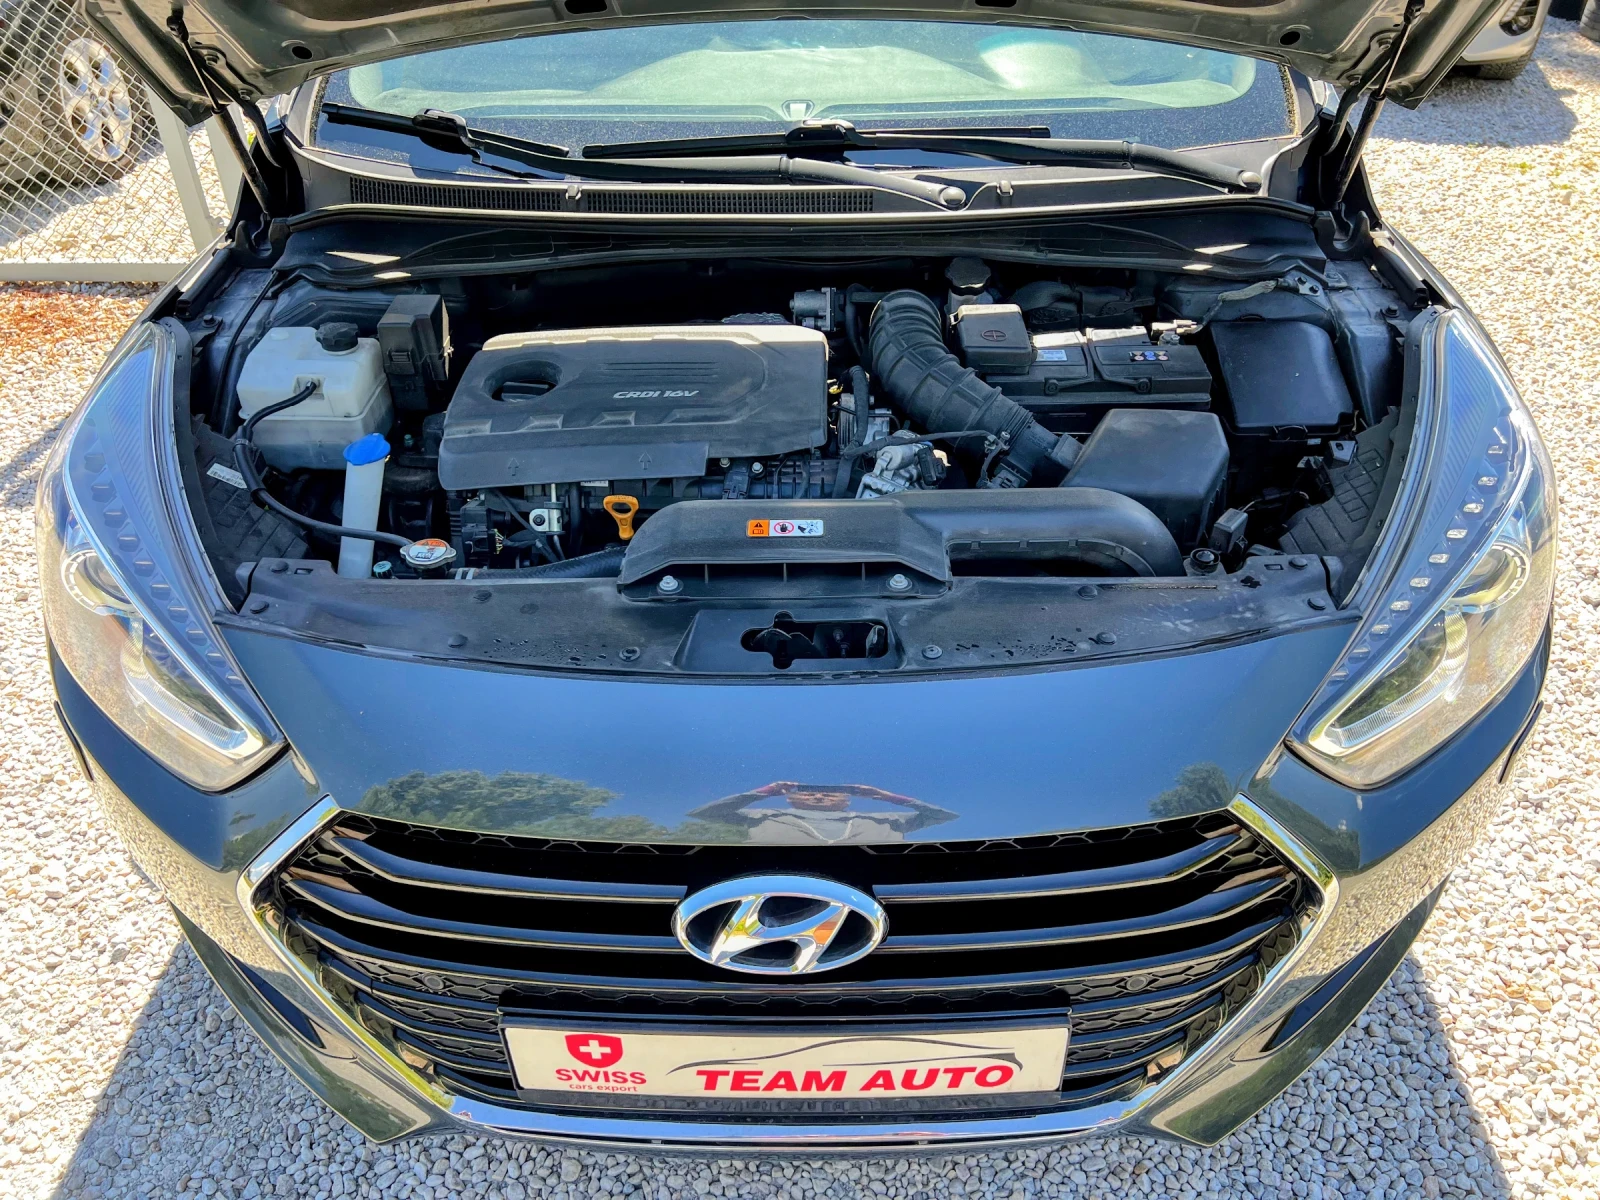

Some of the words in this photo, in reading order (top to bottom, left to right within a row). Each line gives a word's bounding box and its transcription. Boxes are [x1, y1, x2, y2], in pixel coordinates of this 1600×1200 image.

[663, 390, 700, 398] 16V
[555, 1068, 647, 1084] SWISS
[696, 1070, 848, 1092] TEAM
[859, 1065, 1014, 1092] AUTO
[596, 1084, 638, 1092] export
